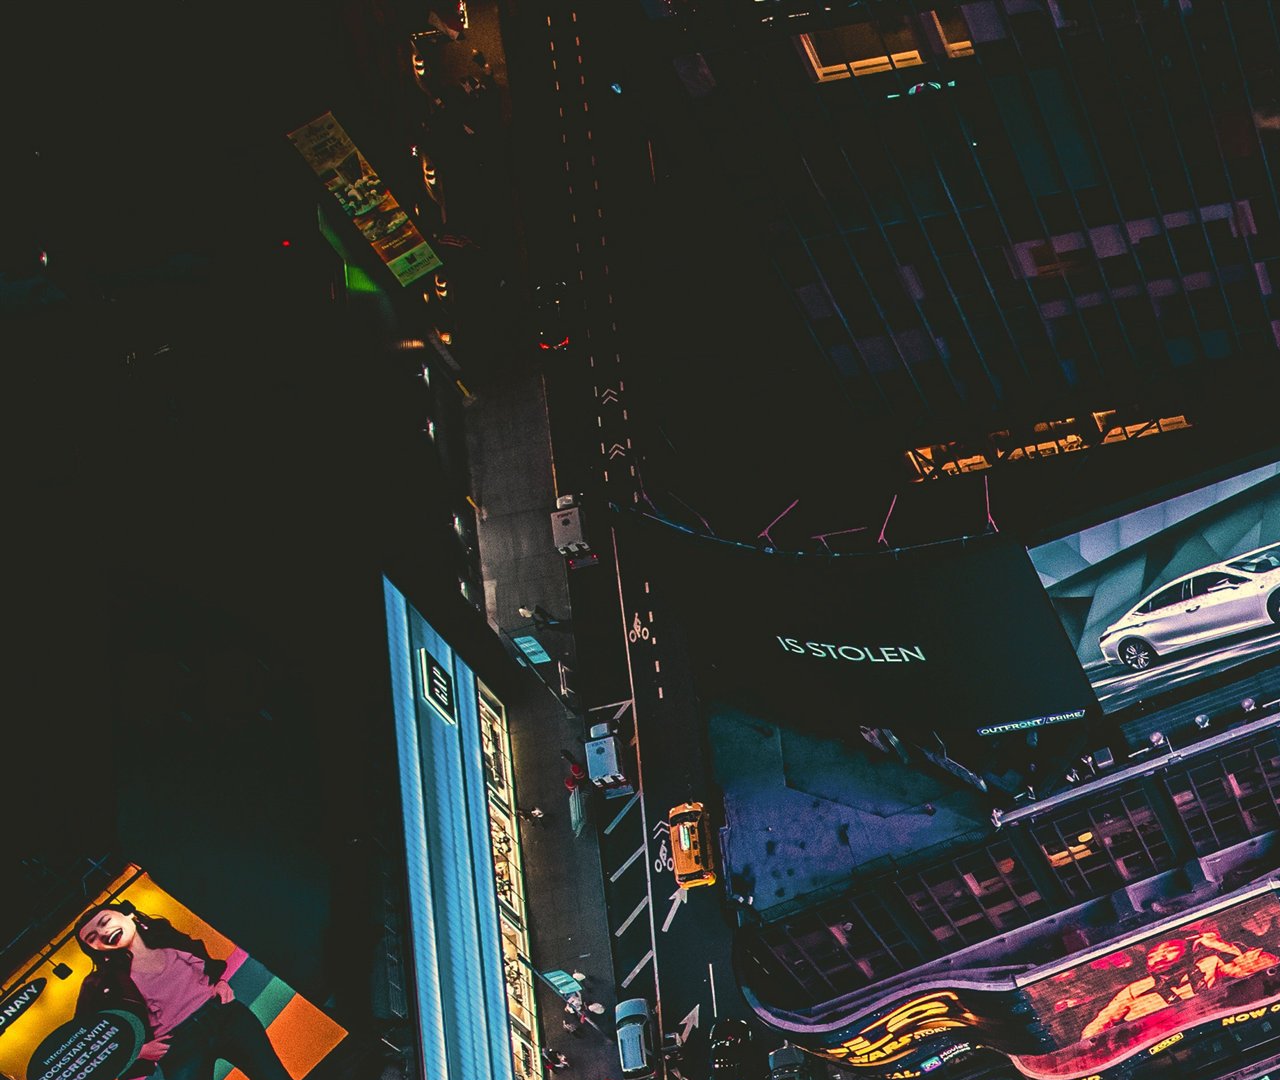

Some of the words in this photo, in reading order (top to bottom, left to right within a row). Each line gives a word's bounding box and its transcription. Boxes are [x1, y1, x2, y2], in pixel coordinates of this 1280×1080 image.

[776, 635, 805, 655] IS
[805, 641, 927, 663] STOLEN
[432, 665, 449, 706] GAP
[5, 984, 39, 1018] NAVY
[1221, 1007, 1268, 1027] NOW
[43, 1026, 88, 1066] introducing
[82, 1018, 111, 1046] WITH
[848, 1033, 914, 1065] WARS
